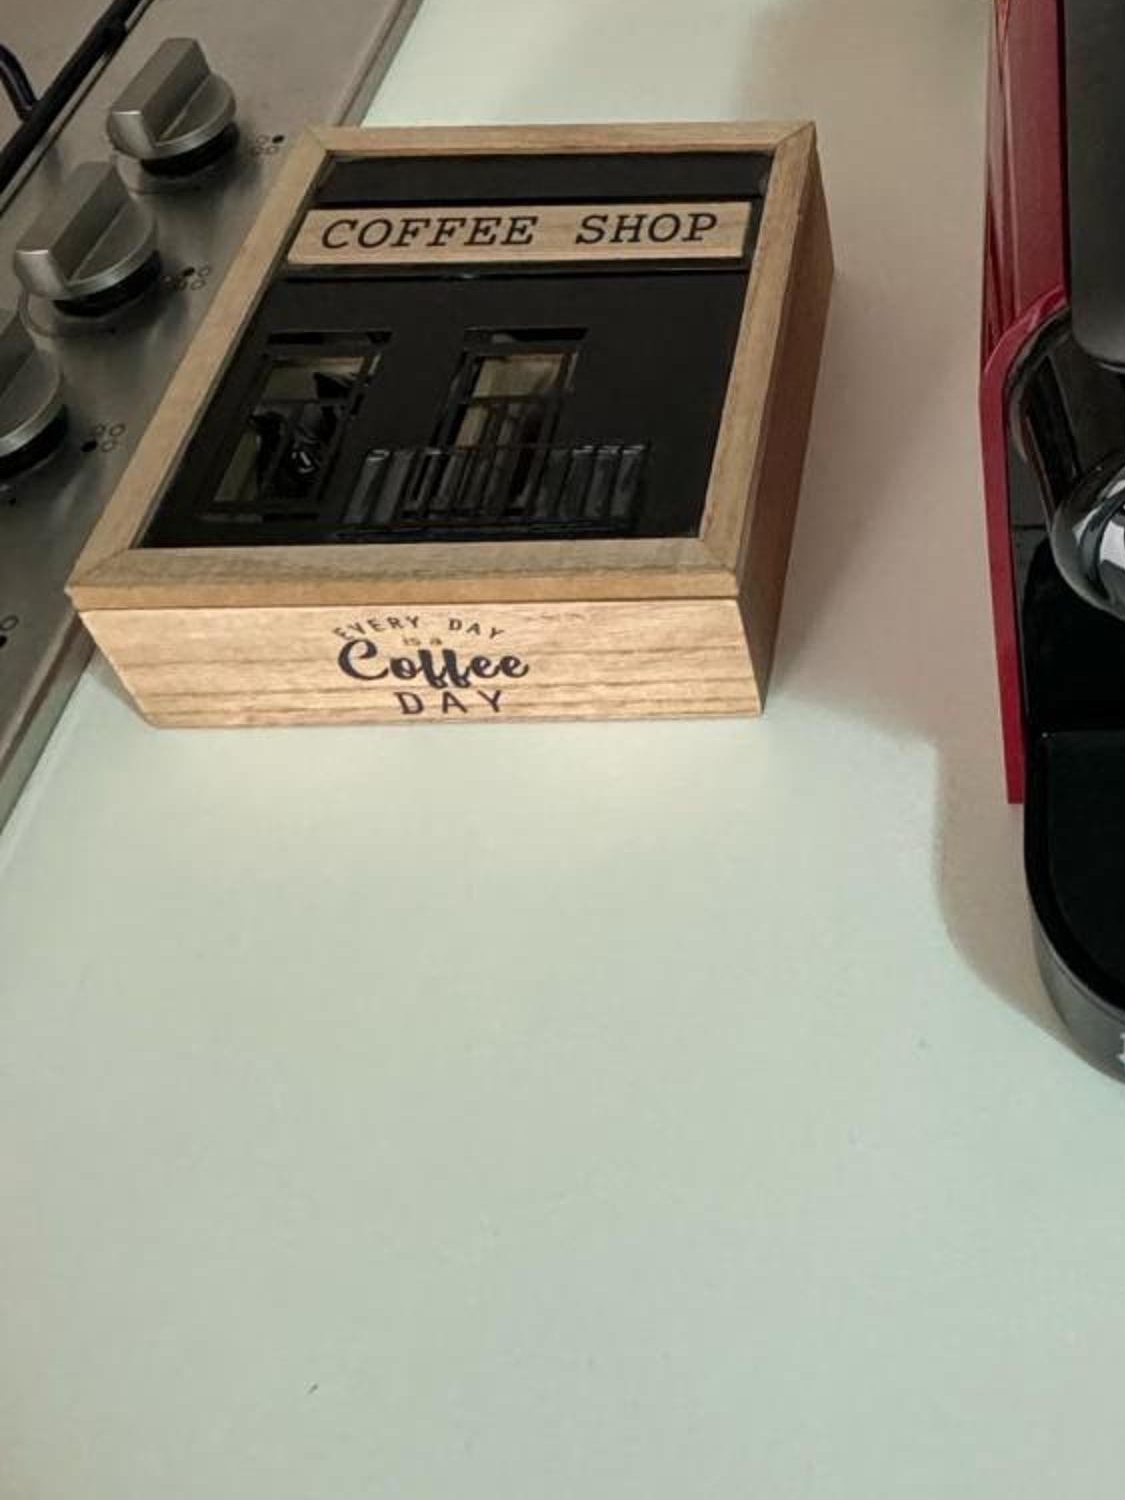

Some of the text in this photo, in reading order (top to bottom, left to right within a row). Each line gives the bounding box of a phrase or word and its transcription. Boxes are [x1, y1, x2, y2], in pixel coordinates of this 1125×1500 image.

[321, 212, 719, 250] COFFEE SHOP
[331, 615, 505, 641] EVERY DAY
[337, 638, 530, 690] Coffee
[394, 689, 503, 715] DAY
